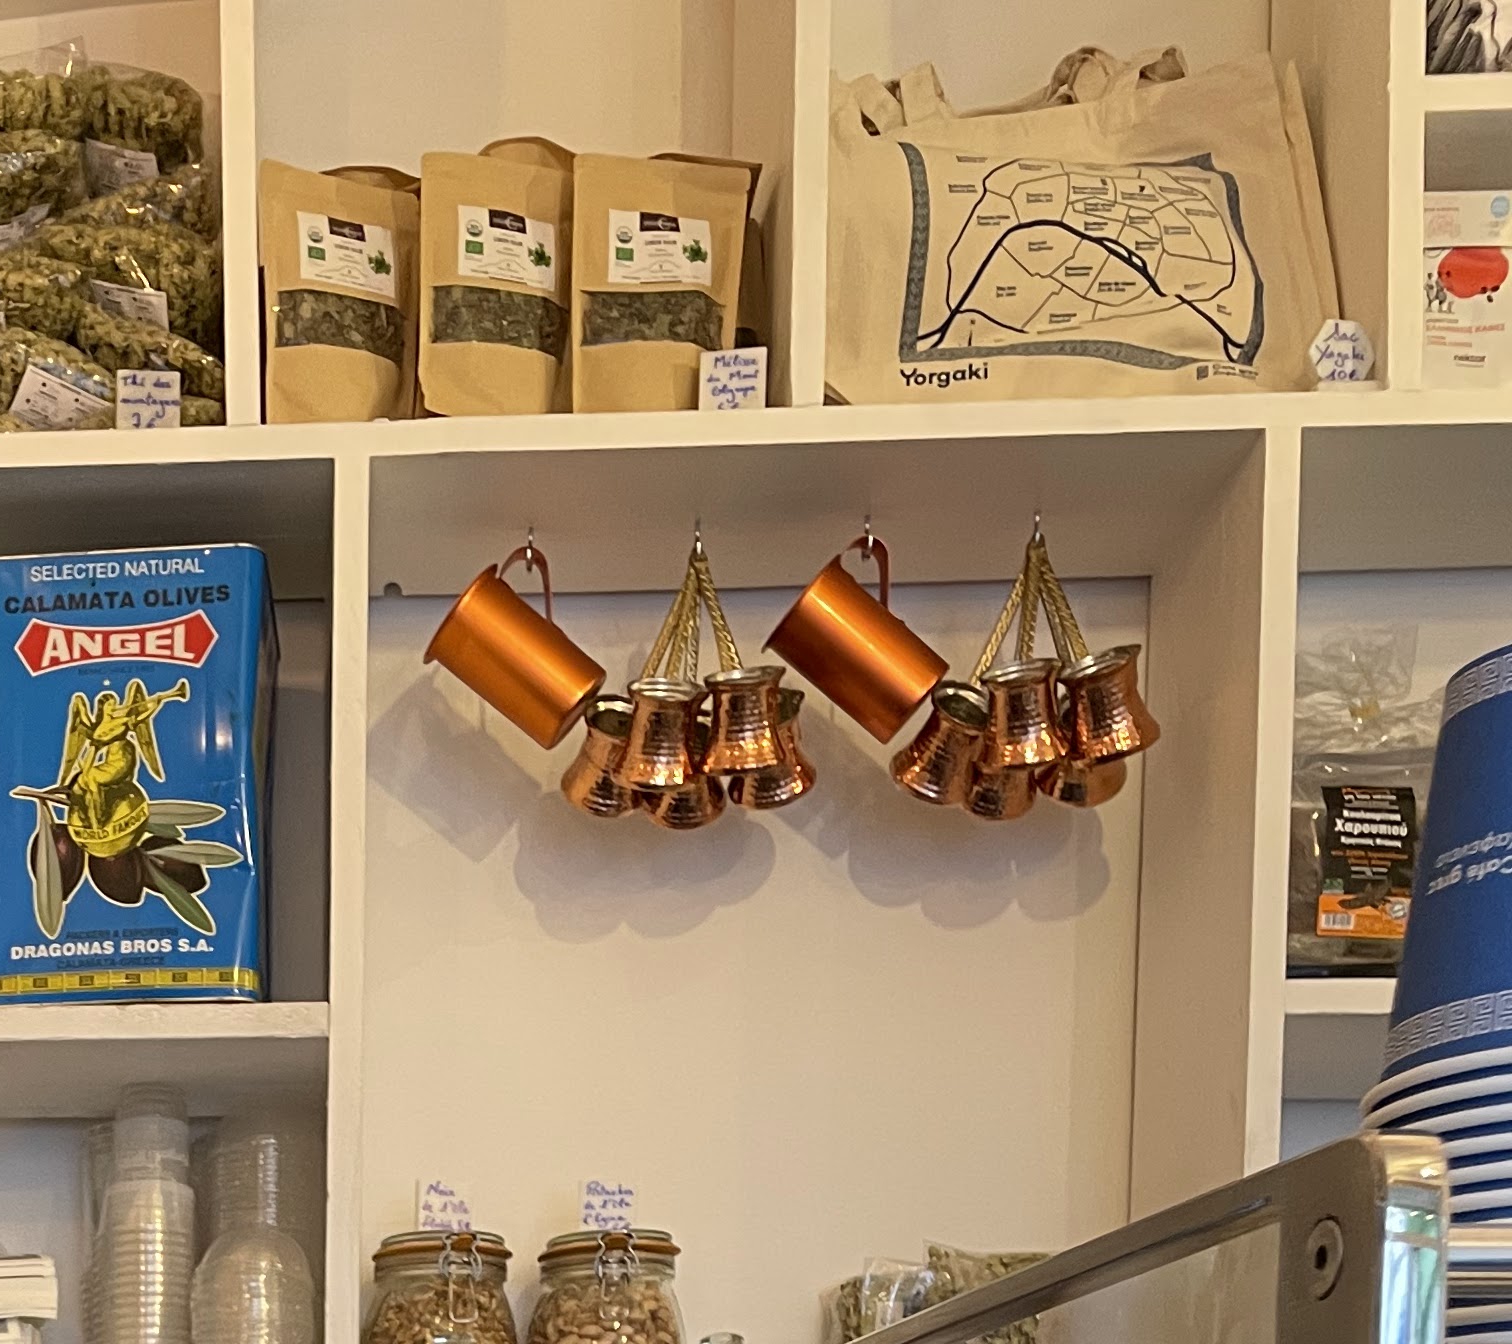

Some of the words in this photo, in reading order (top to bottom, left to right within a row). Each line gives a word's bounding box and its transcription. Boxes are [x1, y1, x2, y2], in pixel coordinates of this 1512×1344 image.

[900, 362, 989, 388] Yorgaki
[30, 562, 120, 582] SELECTED
[124, 557, 205, 577] NATURAL
[4, 590, 136, 614] CALAMATA
[143, 584, 231, 608] OLIVES
[40, 623, 196, 668] ANGEL
[10, 941, 115, 960] DRAGONAS
[120, 938, 173, 954] BROS
[177, 938, 215, 952] S.A.
